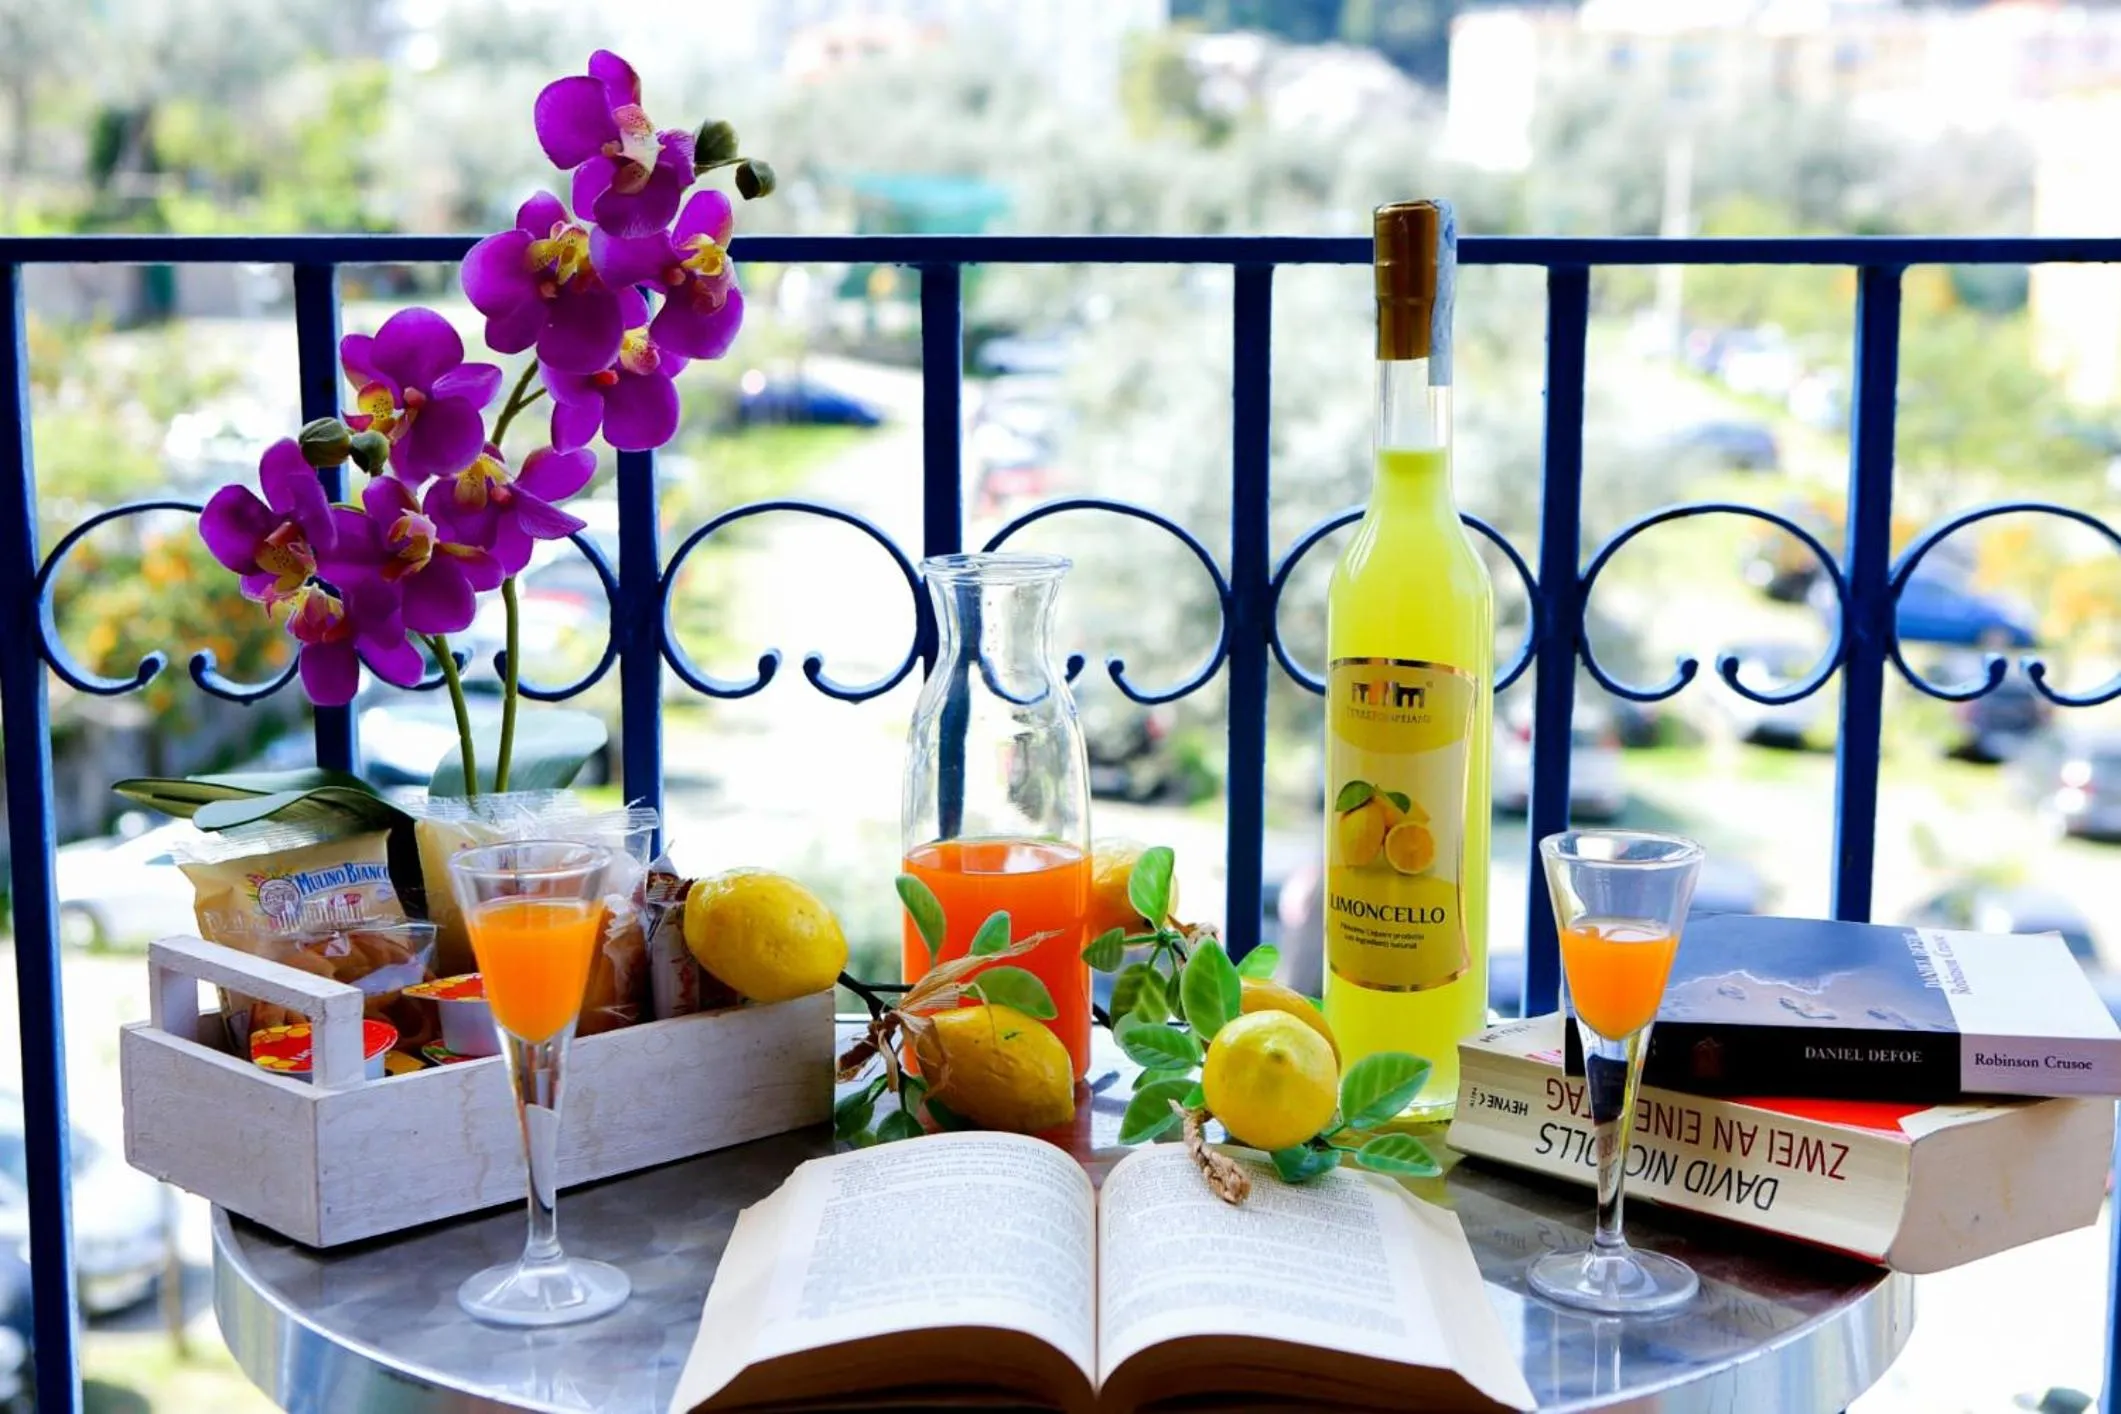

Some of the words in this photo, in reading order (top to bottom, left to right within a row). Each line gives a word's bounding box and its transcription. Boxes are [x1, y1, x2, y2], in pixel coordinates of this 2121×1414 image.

[295, 869, 346, 896] MULINO
[1330, 893, 1445, 924] LIMONCELLO
[1804, 1046, 1864, 1062] DANIEL
[1868, 1048, 1923, 1064] DEFOE
[1974, 1053, 2040, 1070] Robinson
[2044, 1055, 2093, 1071] Crusoe
[1634, 1097, 1702, 1145] EINE
[1713, 1115, 1759, 1159] AN
[1535, 1122, 1680, 1187] NICOLLS
[1767, 1128, 1850, 1181] ZWEI
[1683, 1160, 1779, 1212] DAVID
